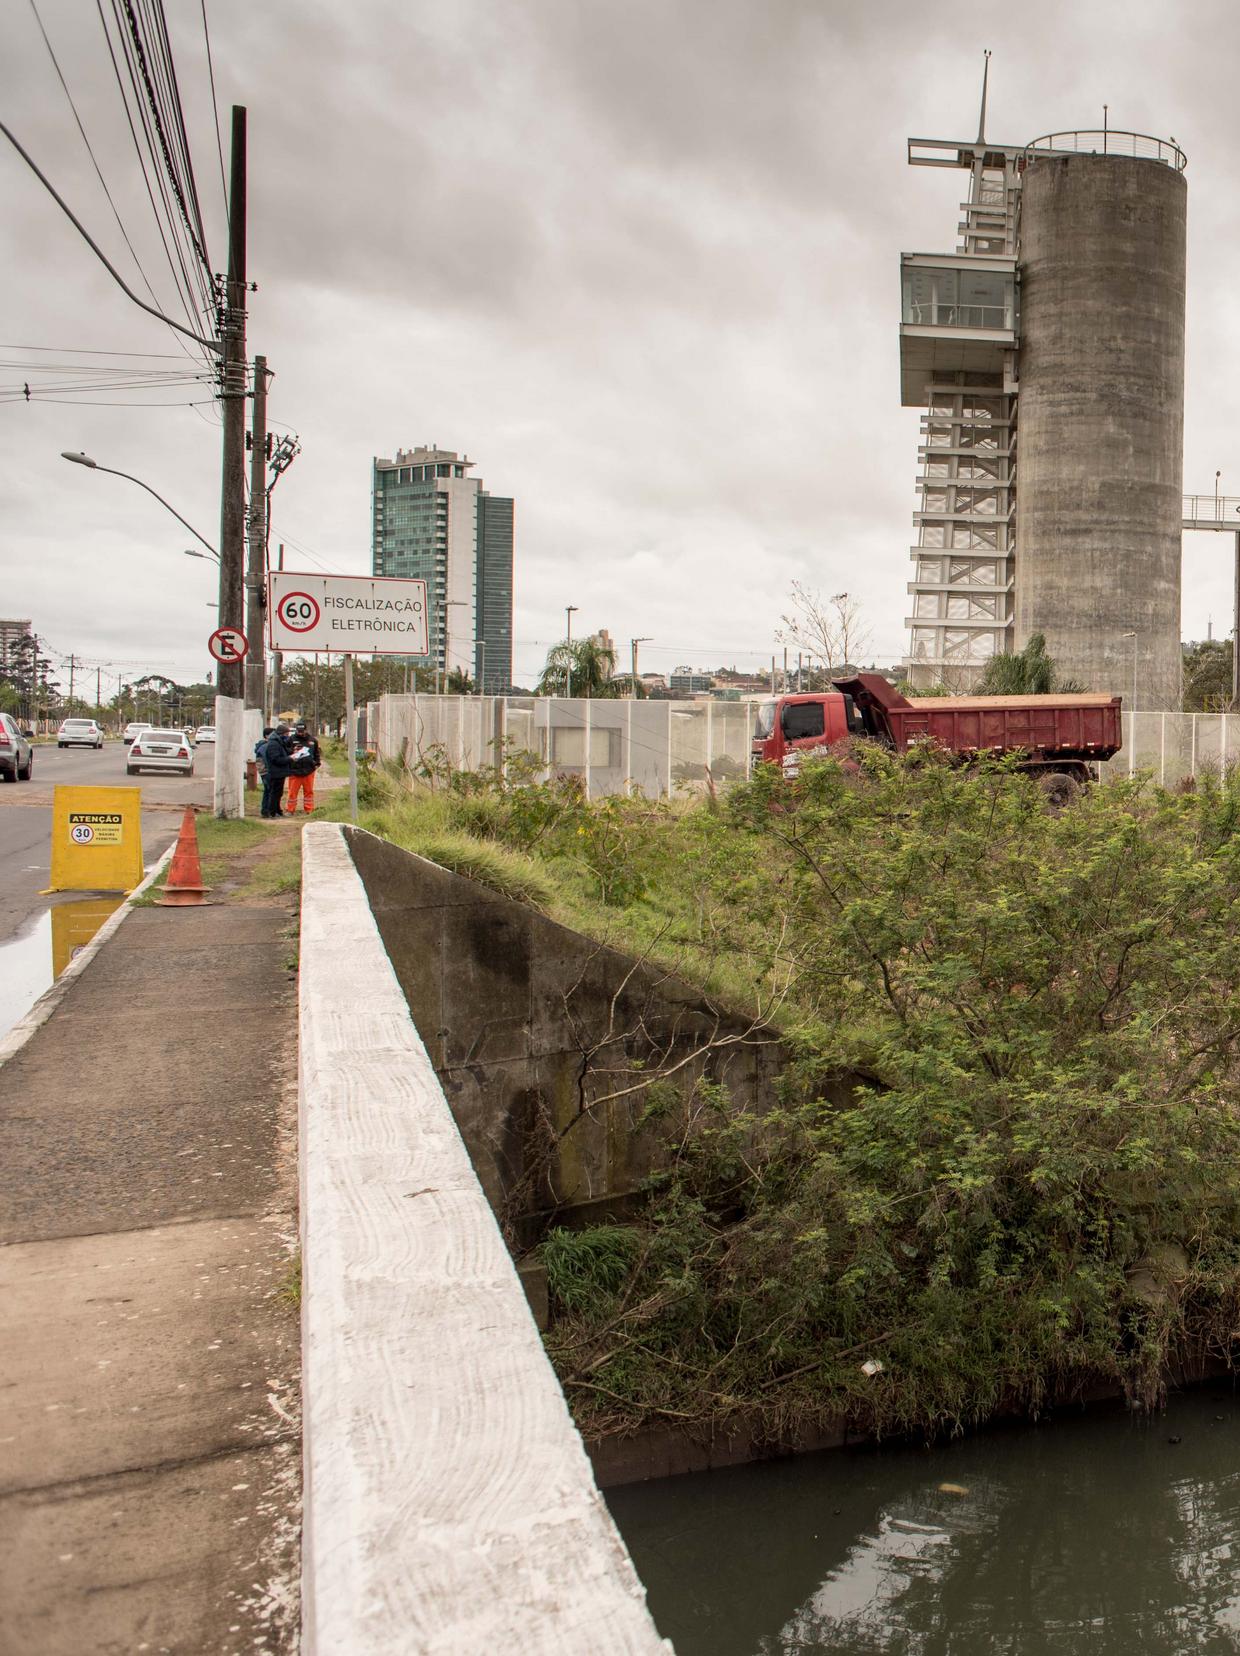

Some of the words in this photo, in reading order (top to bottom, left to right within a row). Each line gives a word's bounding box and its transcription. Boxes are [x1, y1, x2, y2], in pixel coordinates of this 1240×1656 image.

[286, 602, 311, 619] 60
[324, 597, 423, 613] FISCALIZAÇÃO
[332, 617, 416, 633] ELETRÔNICA
[72, 816, 120, 824] ATENÇÃO
[76, 828, 90, 838] 30
